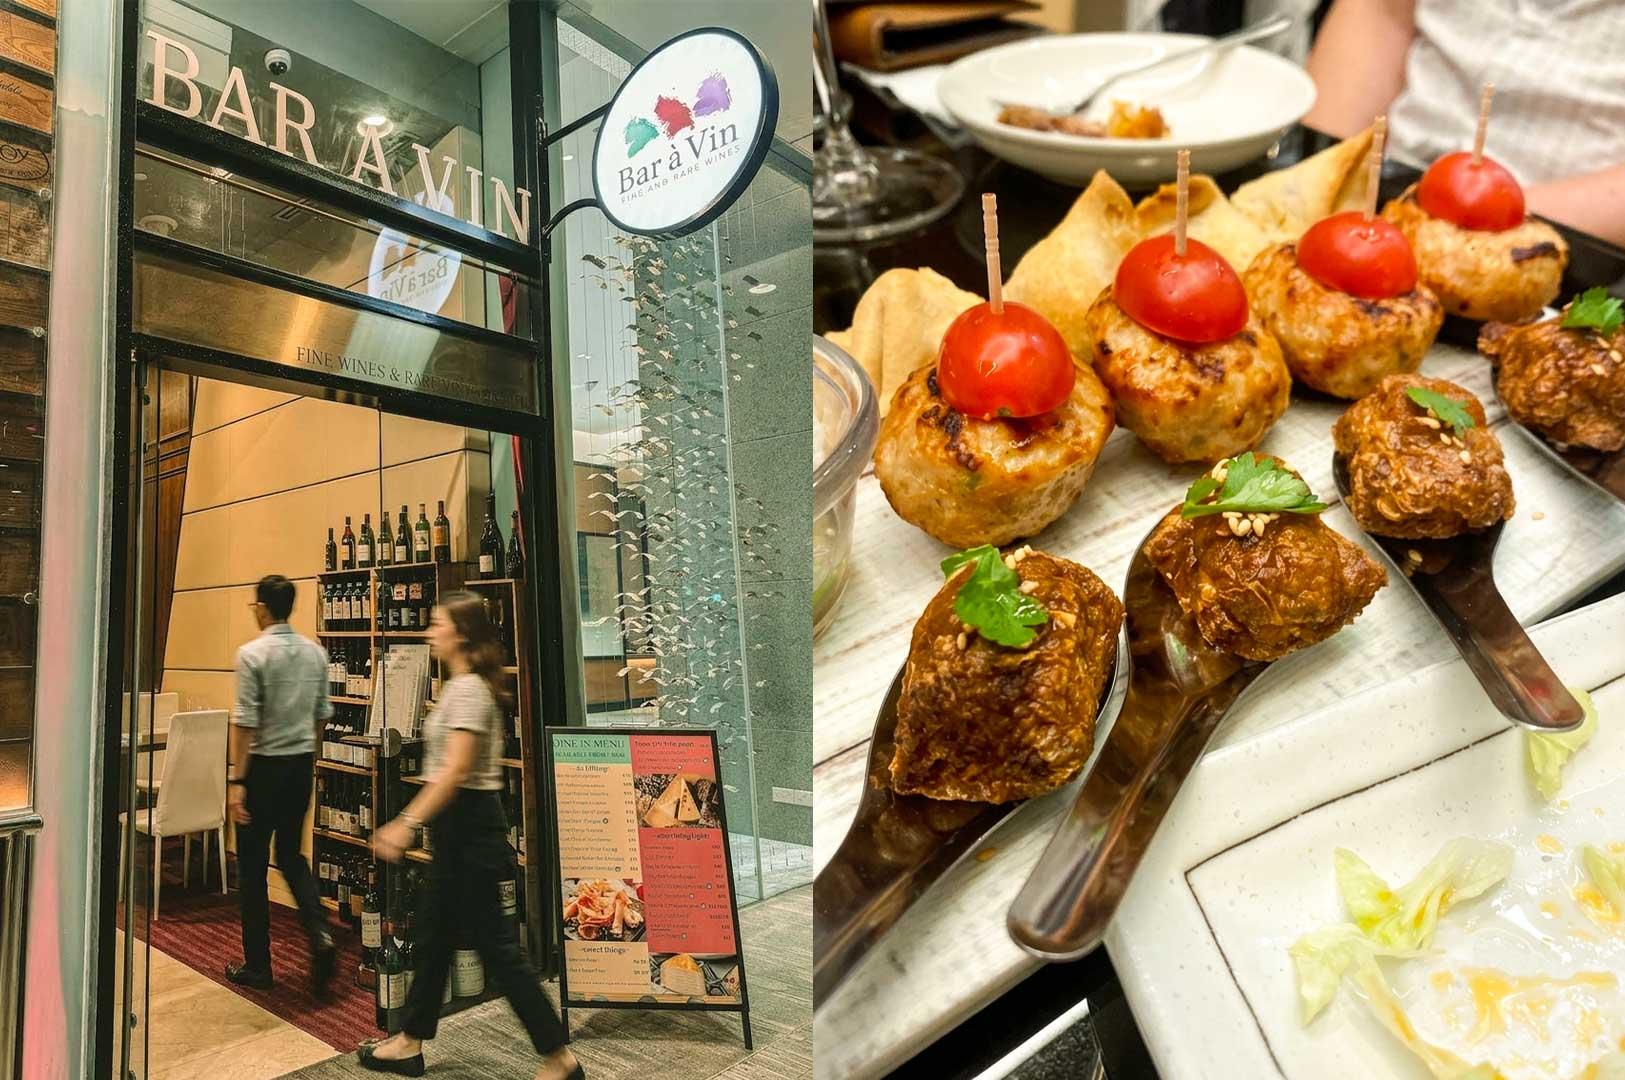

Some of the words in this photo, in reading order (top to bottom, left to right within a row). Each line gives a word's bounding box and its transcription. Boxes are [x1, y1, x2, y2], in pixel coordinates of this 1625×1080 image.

[144, 30, 325, 169] BAR
[412, 143, 532, 245] VIN
[618, 158, 662, 195] Bar
[668, 144, 683, 171] à
[684, 123, 740, 160] Vin
[673, 164, 700, 181] RARE
[704, 144, 742, 166] WINES
[296, 346, 333, 368] FINE
[337, 355, 386, 379] WINES
[389, 367, 401, 383] &
[405, 370, 438, 389] RARE
[553, 739, 578, 748] DINE
[580, 739, 591, 748] IN
[593, 739, 625, 748] MENU
